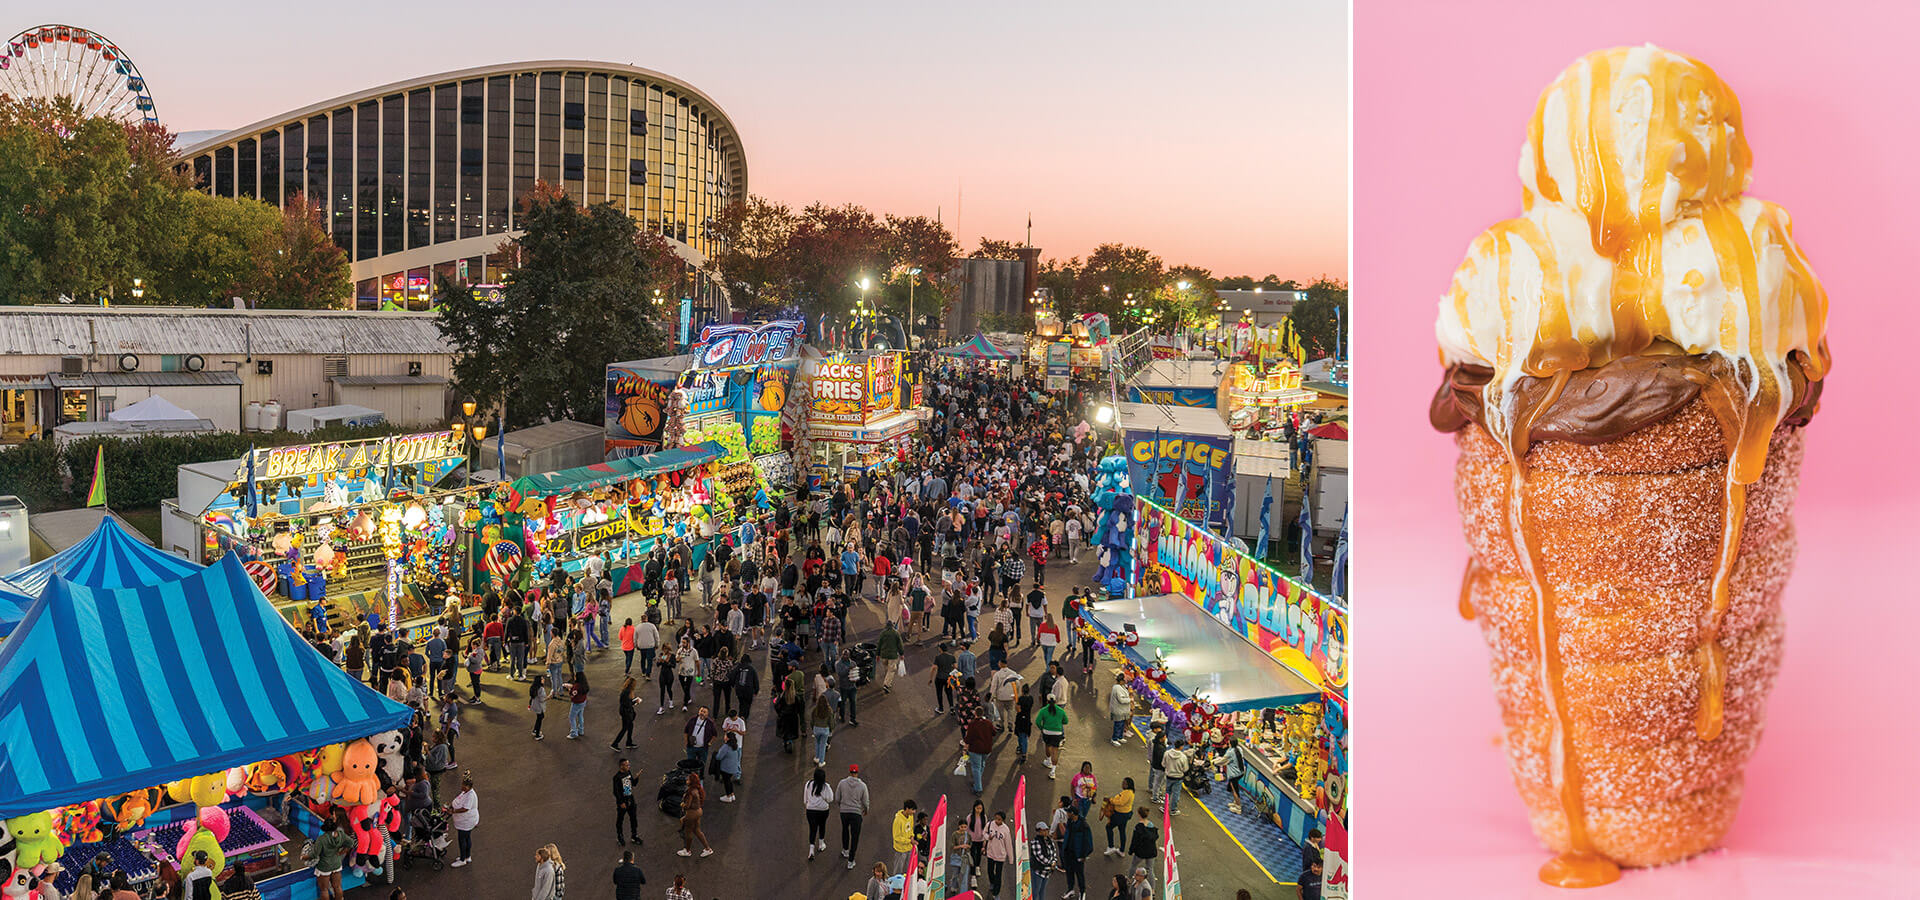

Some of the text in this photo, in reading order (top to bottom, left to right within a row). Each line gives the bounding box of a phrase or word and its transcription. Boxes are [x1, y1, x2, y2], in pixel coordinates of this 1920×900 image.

[728, 330, 793, 365] HOOPS
[757, 366, 789, 384] CHOICE
[812, 363, 864, 379] JACK'S
[902, 345, 914, 385] ATM
[615, 376, 669, 405] CHOICE
[811, 380, 863, 401] FRIES
[1140, 391, 1174, 405] WIN
[266, 432, 450, 478] BREAK A BOTTLE
[1133, 439, 1228, 469] CHOICE
[1157, 534, 1217, 601] BALLOON
[1244, 582, 1319, 661] BLAST
